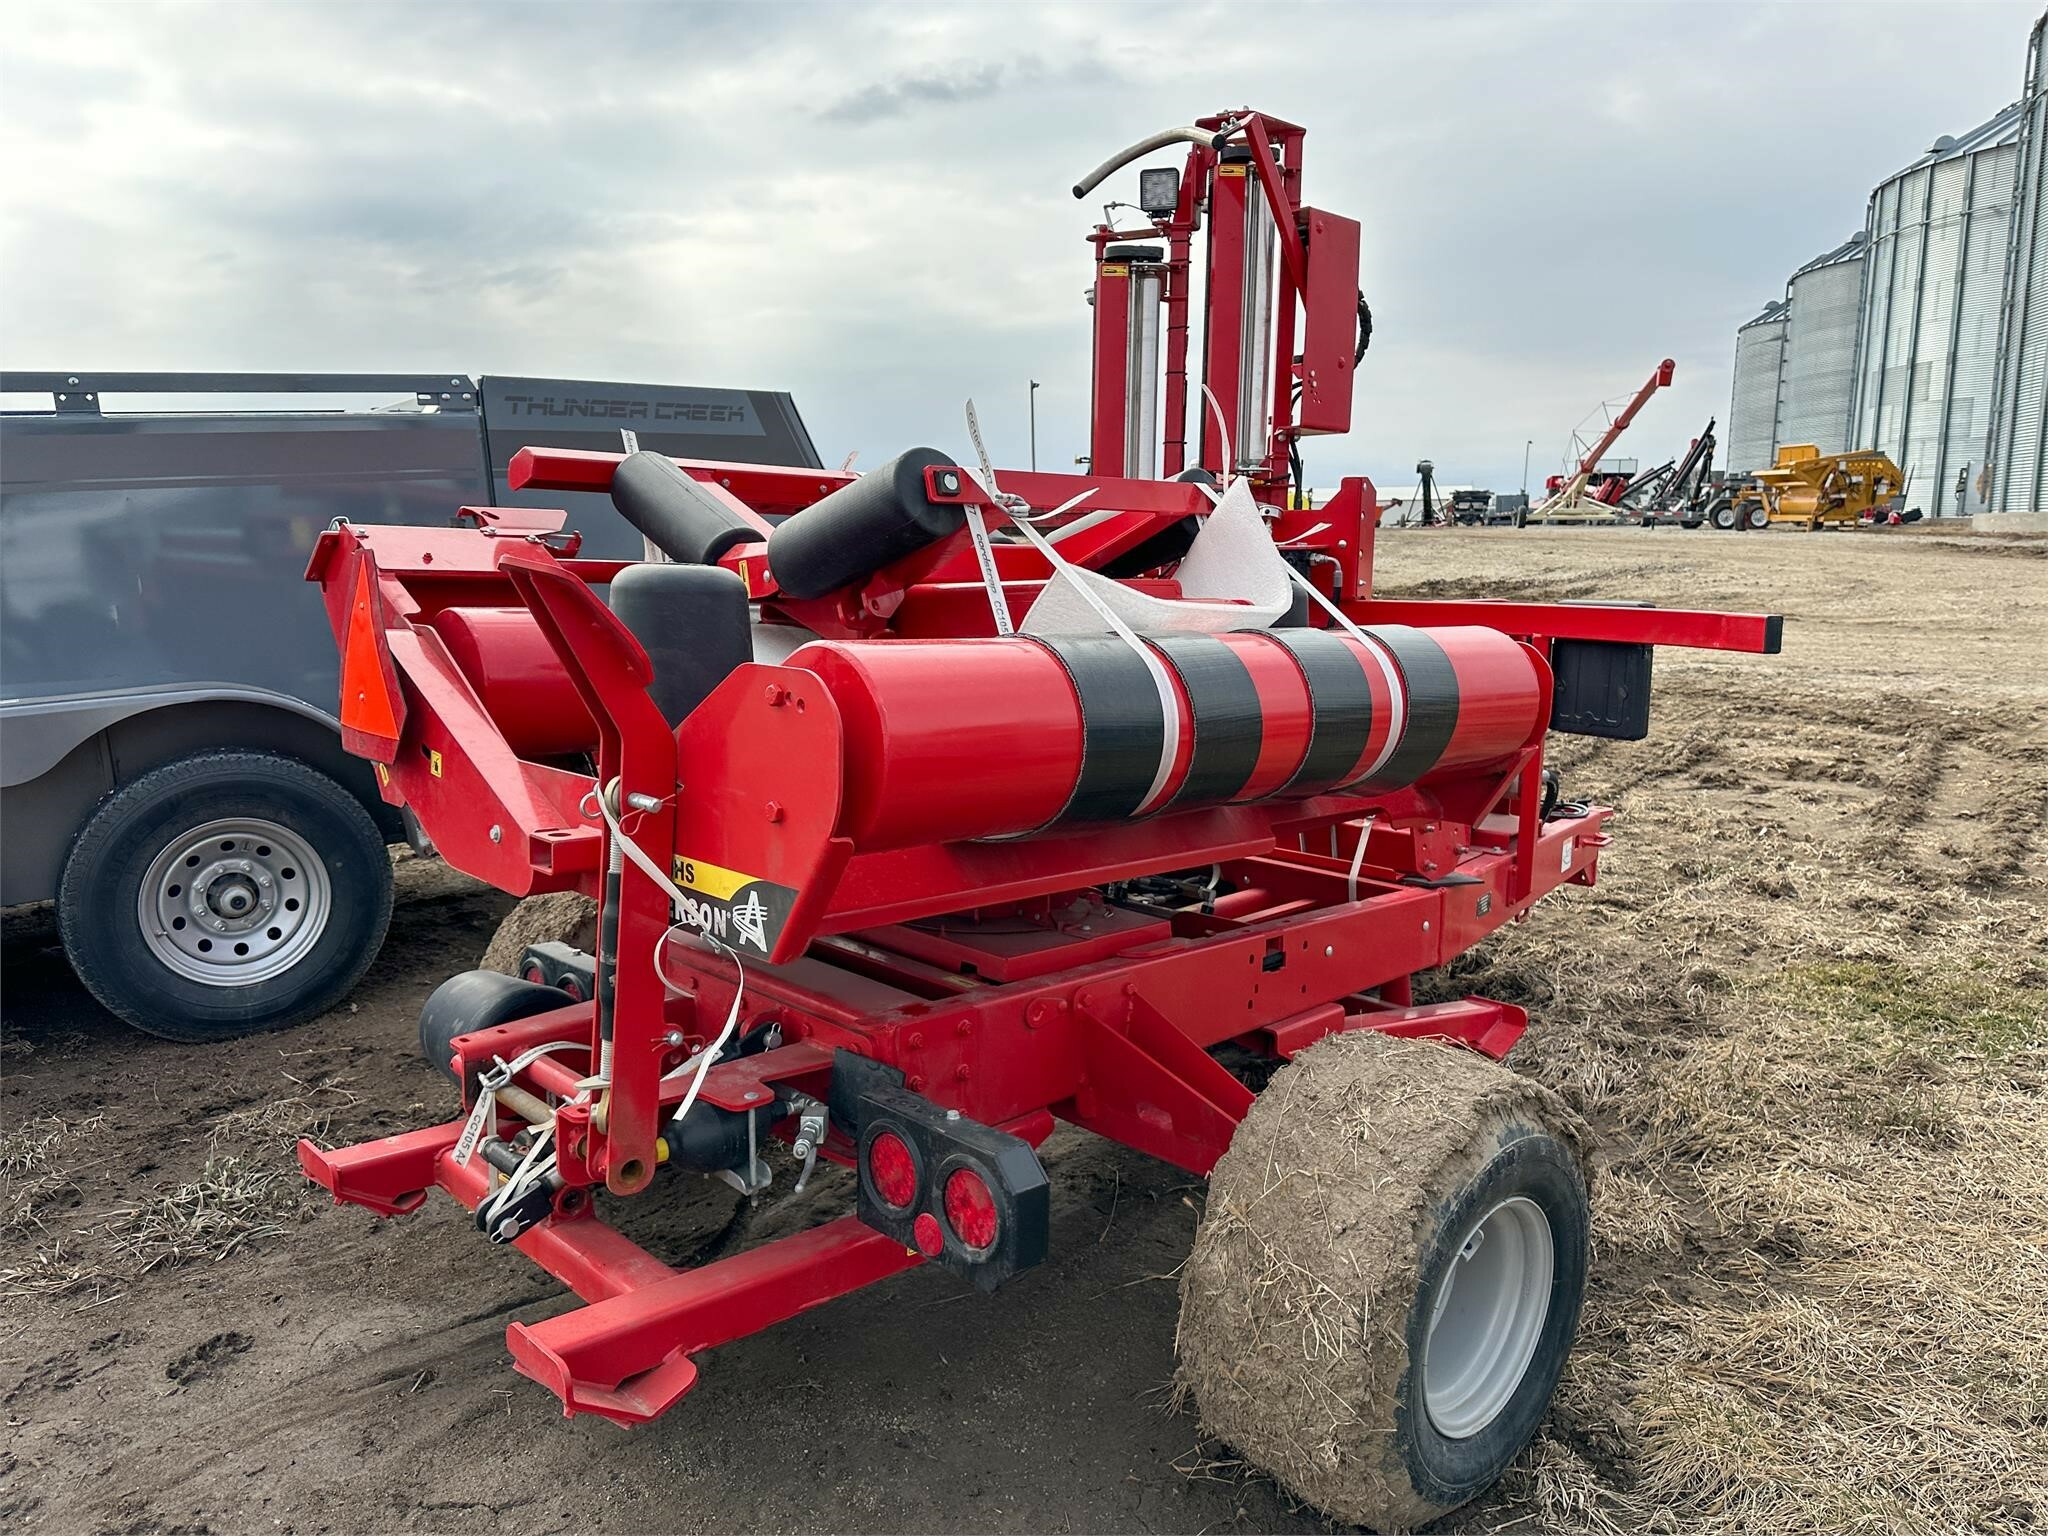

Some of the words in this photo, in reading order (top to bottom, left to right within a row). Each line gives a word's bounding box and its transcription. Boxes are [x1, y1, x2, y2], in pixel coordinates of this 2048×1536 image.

[503, 395, 648, 420] THUNDER
[654, 402, 745, 423] CREEK
[976, 533, 997, 594] cordstrap
[993, 600, 1010, 634] CC105
[461, 1114, 481, 1151] CC105
